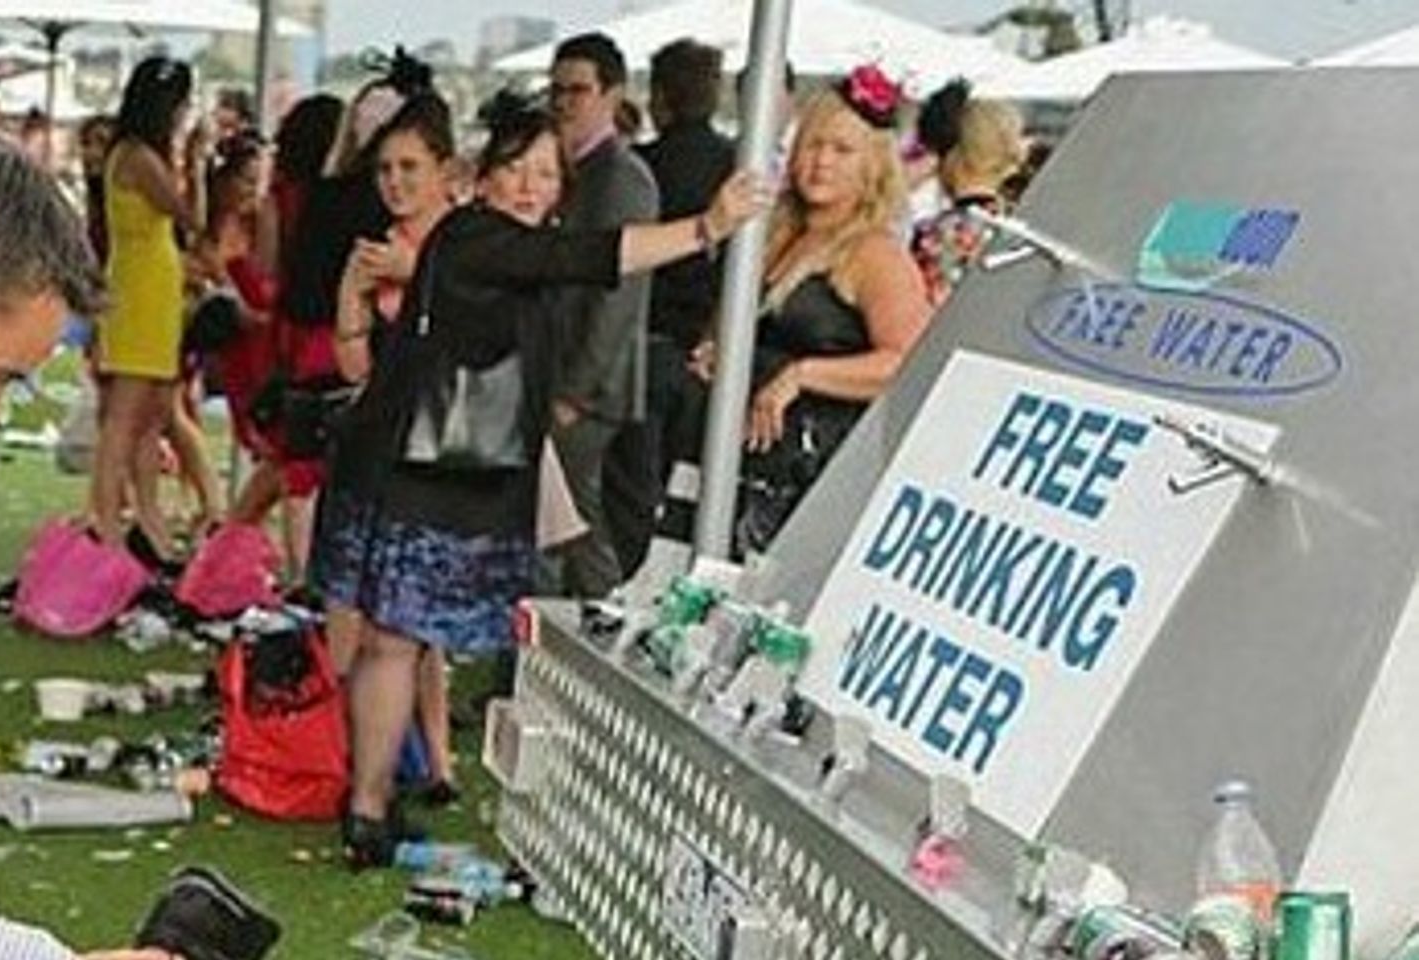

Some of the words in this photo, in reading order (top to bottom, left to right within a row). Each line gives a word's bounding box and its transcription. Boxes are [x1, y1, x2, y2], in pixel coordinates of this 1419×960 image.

[1149, 307, 1293, 383] WATER
[972, 391, 1149, 520] FREE
[862, 486, 1138, 673] DRINKING
[837, 604, 1026, 774] WATER
